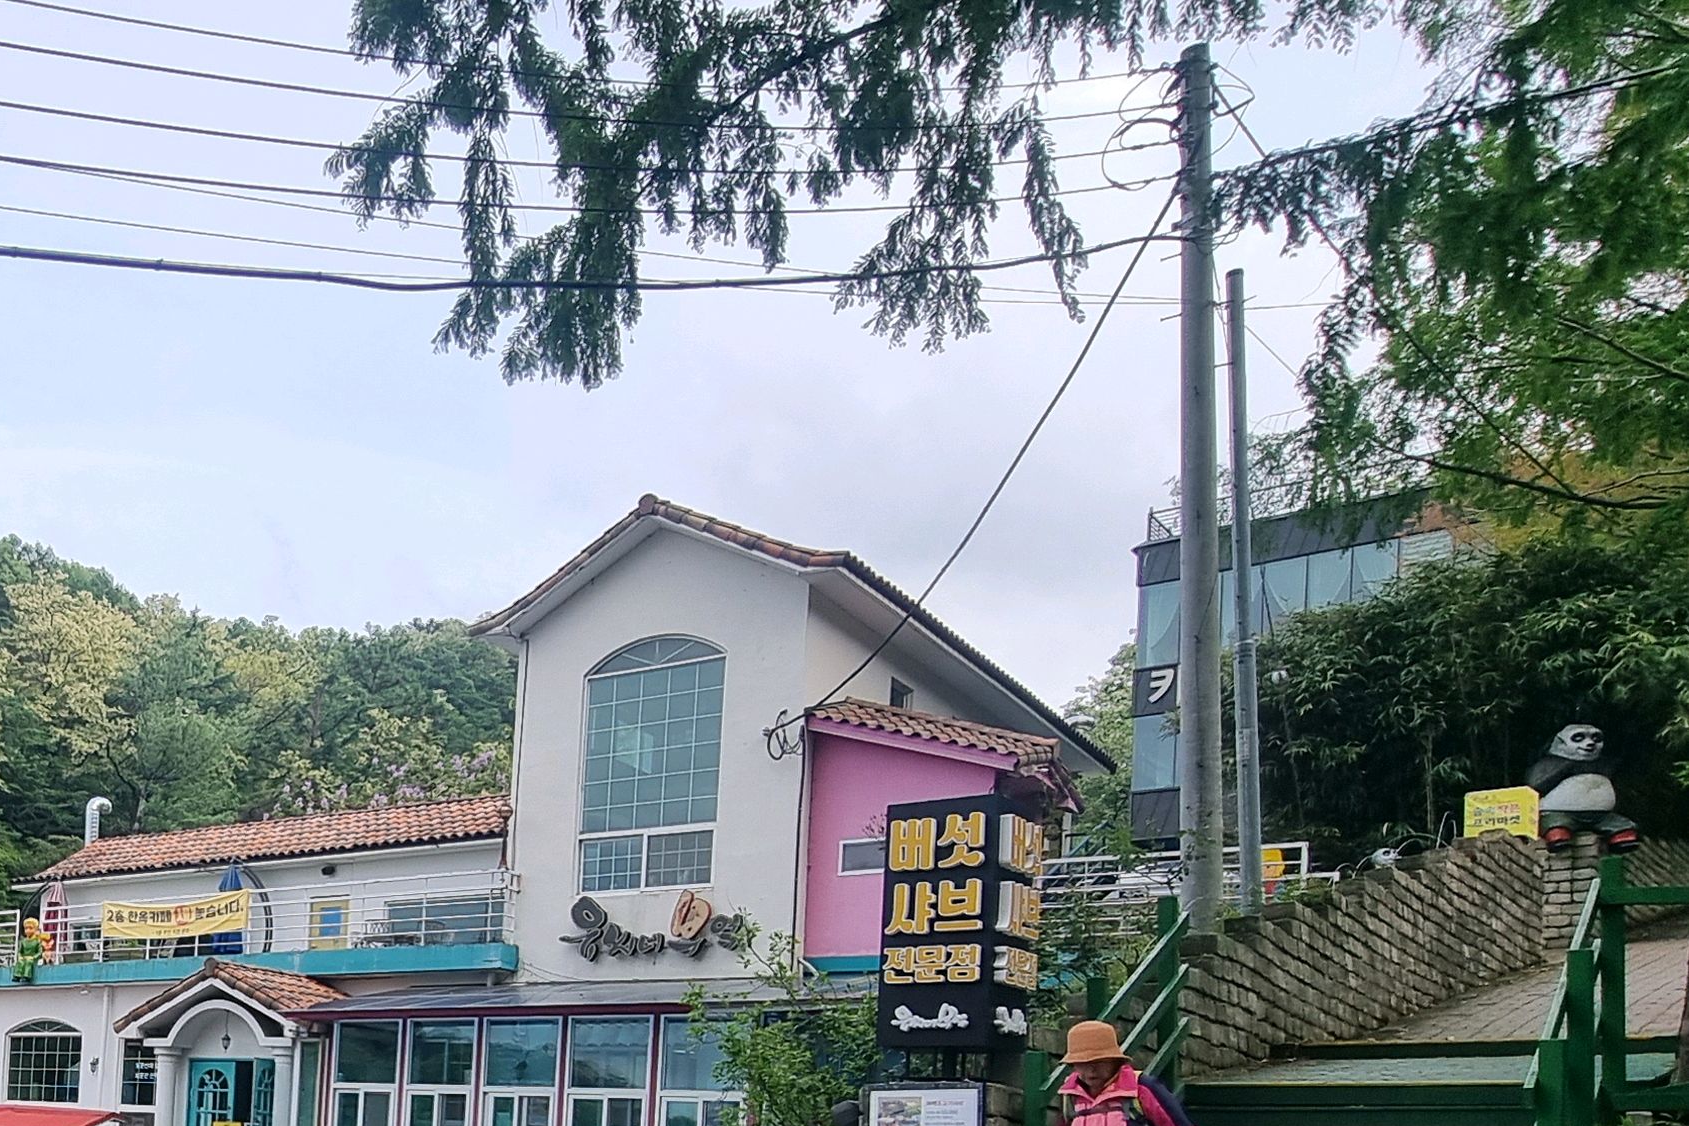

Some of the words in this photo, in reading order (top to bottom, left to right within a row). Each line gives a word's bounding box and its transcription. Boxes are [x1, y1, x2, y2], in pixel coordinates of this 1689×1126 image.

[888, 811, 985, 871] 버섯
[884, 878, 983, 934] 샤브
[882, 944, 982, 984] 전문점
